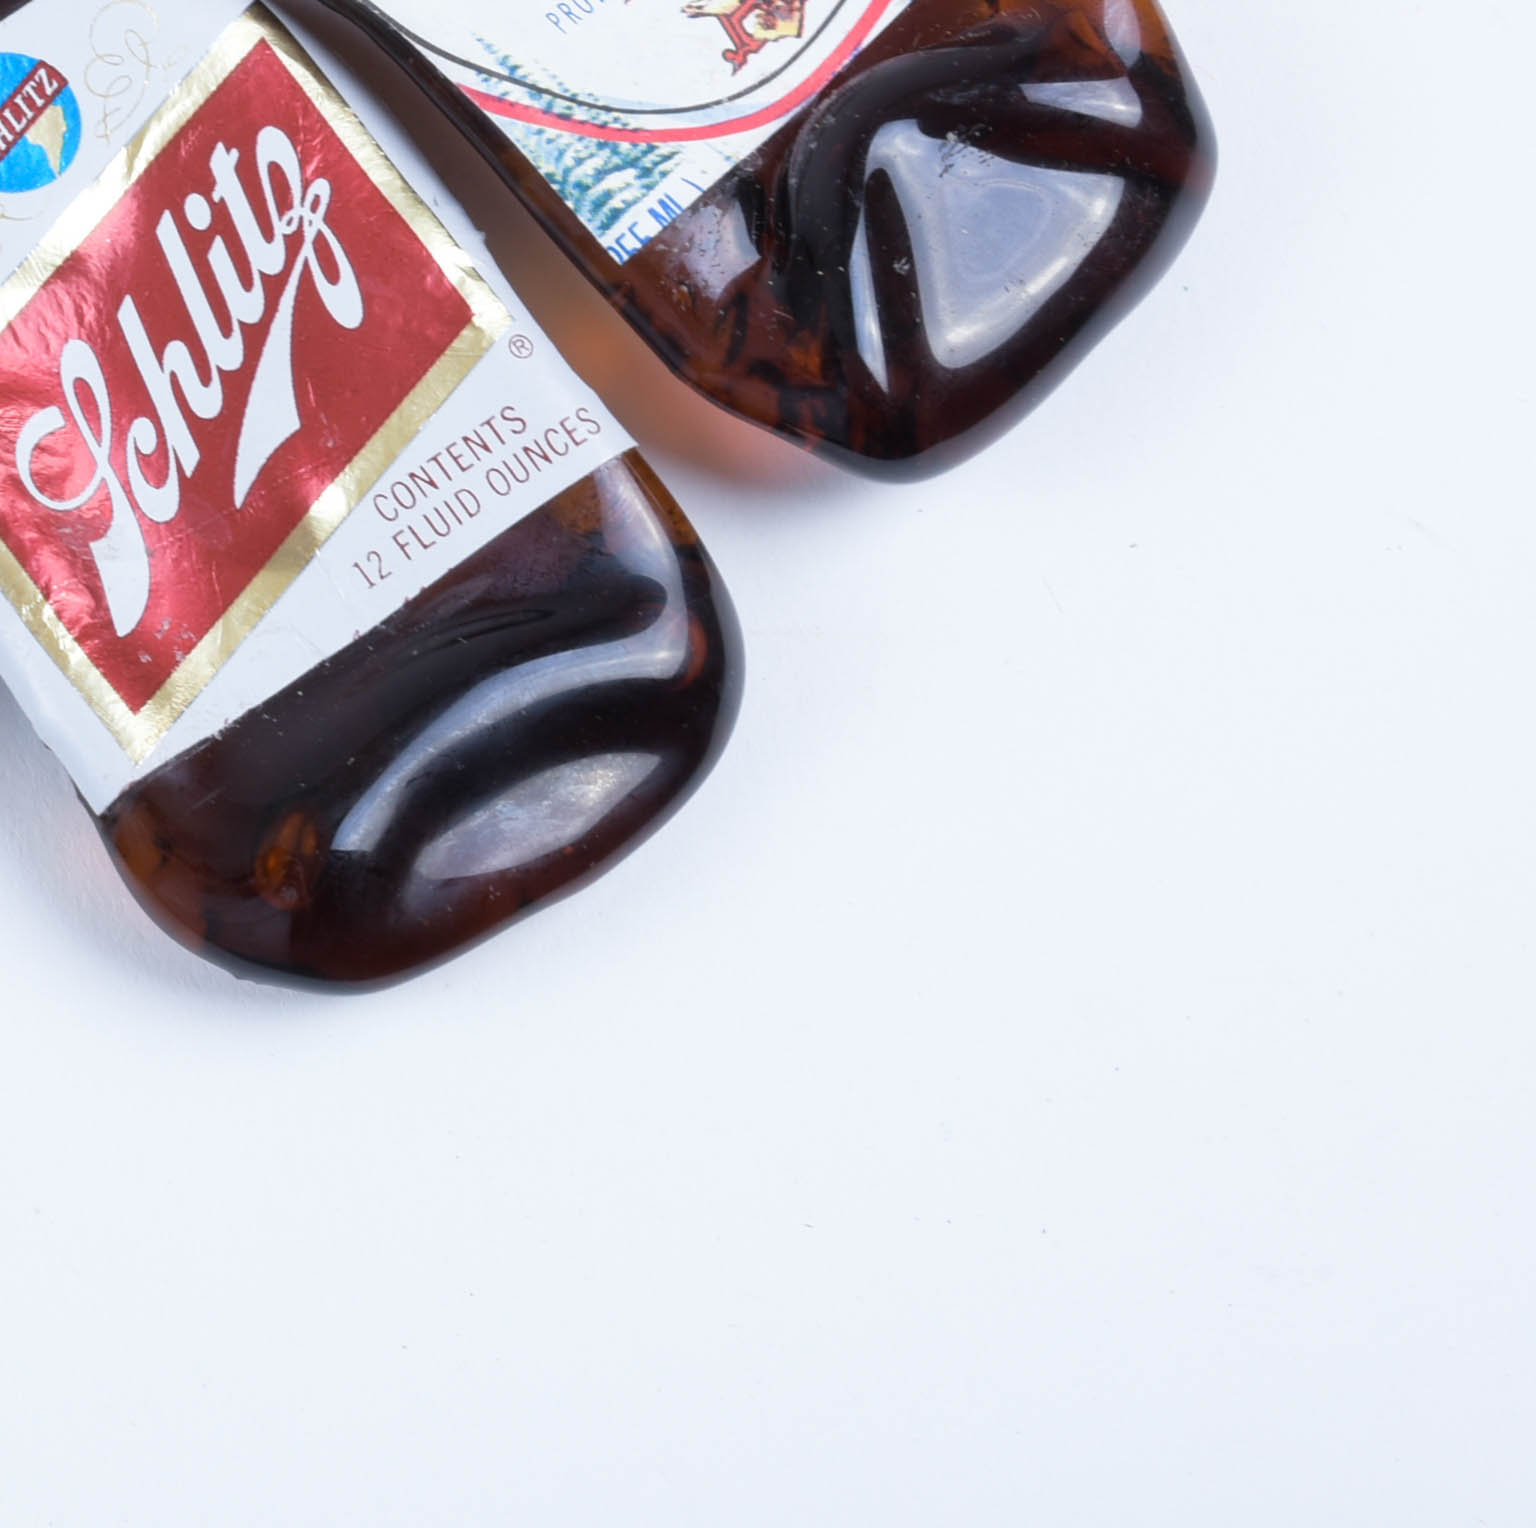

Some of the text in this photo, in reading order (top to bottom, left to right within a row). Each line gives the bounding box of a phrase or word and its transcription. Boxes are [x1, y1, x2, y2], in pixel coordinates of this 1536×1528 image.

[15, 124, 365, 637] Schlitz
[373, 406, 528, 523] CONTENTS
[352, 407, 602, 590] 12 FLUID OUNCES
